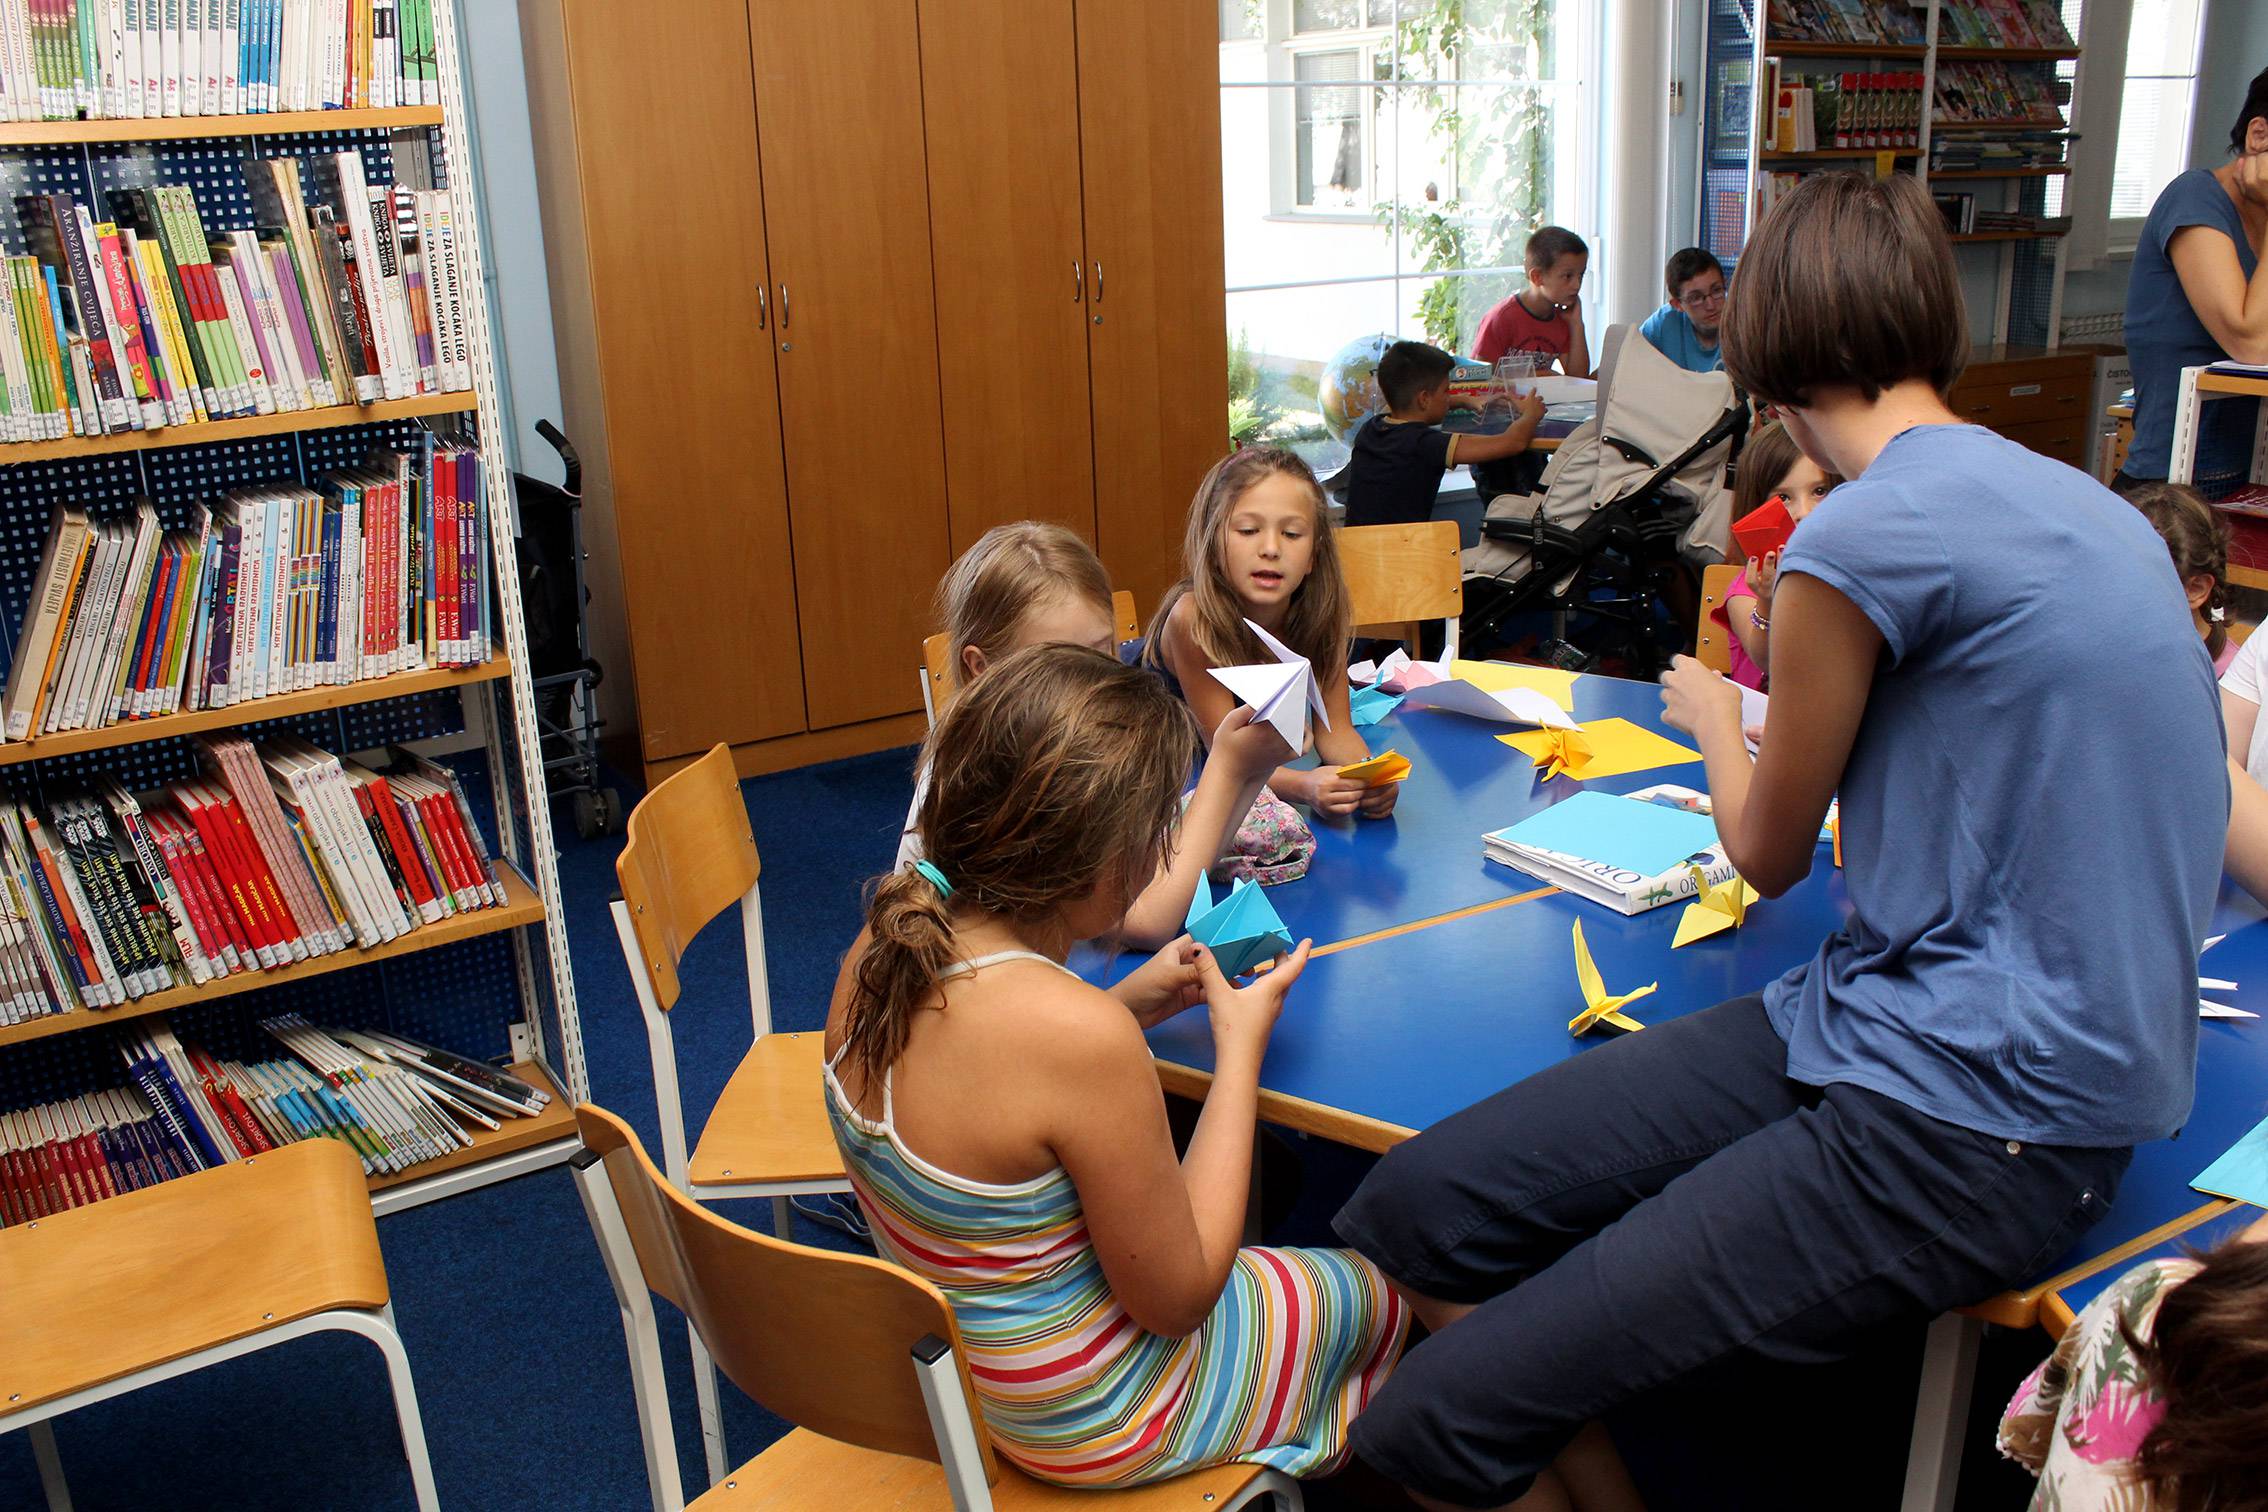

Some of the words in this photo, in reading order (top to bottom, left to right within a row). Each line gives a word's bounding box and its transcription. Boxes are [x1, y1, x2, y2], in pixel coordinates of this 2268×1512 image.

[165, 215, 183, 259] KUHARICA
[178, 214, 196, 259] KUHARICA
[190, 214, 207, 257] KUHARICA
[370, 203, 382, 230] KNJIGA
[378, 244, 390, 275] SVIJETA
[378, 202, 388, 229] KNJIGA
[385, 242, 396, 273] SVIJETA
[440, 211, 451, 236] IDEJE
[443, 237, 452, 249] ZA
[423, 213, 432, 238] IDEJE
[429, 253, 441, 299] SLAGANJE
[440, 340, 450, 363] LEGO
[444, 251, 458, 297] SLAGANJE
[83, 290, 102, 335] CVIJEĆA
[372, 293, 382, 314] druga
[376, 319, 387, 343] strojevi
[455, 338, 465, 361] LEGO
[2107, 369, 2132, 379] ČISTO
[434, 495, 445, 520] ART
[446, 495, 456, 521] ART
[467, 501, 475, 517] ART
[201, 521, 211, 544] CRTANJE
[53, 531, 77, 580] UMJETNOSTI
[224, 568, 237, 613] CRTATI
[239, 562, 248, 607] RADIONICA
[250, 559, 260, 603] RADIONICA
[277, 554, 286, 599] RADIONICA
[44, 582, 64, 615] SVIJETA
[86, 611, 98, 637] KIRIGAMI
[104, 562, 112, 577] TEČAJ
[99, 609, 111, 635] KIRIGAMI
[117, 560, 126, 575] TEČAJ
[75, 613, 87, 639] KIRIGAMI
[236, 609, 245, 656] KREATIVNA
[247, 606, 256, 652] KREATIVNA
[273, 601, 282, 647] KREATIVNA
[439, 611, 447, 636] F.Watt
[450, 611, 459, 636] F.Watt
[311, 811, 332, 847] obiteljske
[328, 806, 350, 842] obiteljske
[345, 801, 366, 836] obiteljske
[108, 852, 123, 872] ZNATI
[134, 838, 157, 875] OXFORD
[135, 814, 151, 840] KNJIGA
[150, 849, 168, 878] SVIJETA
[80, 859, 95, 880] ZNATI
[93, 856, 108, 877] ZNATI
[117, 872, 131, 892] ŽELIŠ
[1680, 865, 1736, 894] ORGAMI
[34, 867, 53, 903] GLAZBALA
[72, 886, 87, 912] LIKOVA
[89, 880, 103, 900] ŽELIŠ
[102, 876, 116, 896] ŽELIŠ
[125, 891, 137, 905] ŠTO
[231, 883, 250, 914] MAGIČAR
[245, 879, 265, 911] MAGIČAR
[262, 874, 281, 906] MAGIČAR
[48, 902, 66, 934] ZVUKOVI
[97, 899, 109, 914] ŠTO
[109, 895, 122, 910] ŠTO
[115, 909, 127, 924] SVE
[130, 905, 143, 919] SVE
[102, 913, 114, 927] SVE
[108, 927, 130, 965] APSOLUTNO
[121, 923, 143, 961] APSOLUTNO
[136, 918, 158, 956] APSOLUTNO
[178, 937, 195, 957] FILM
[164, 1118, 179, 1136] IGRE
[223, 1111, 250, 1151] SPORTOVI
[241, 1110, 268, 1149] SPORTOVI
